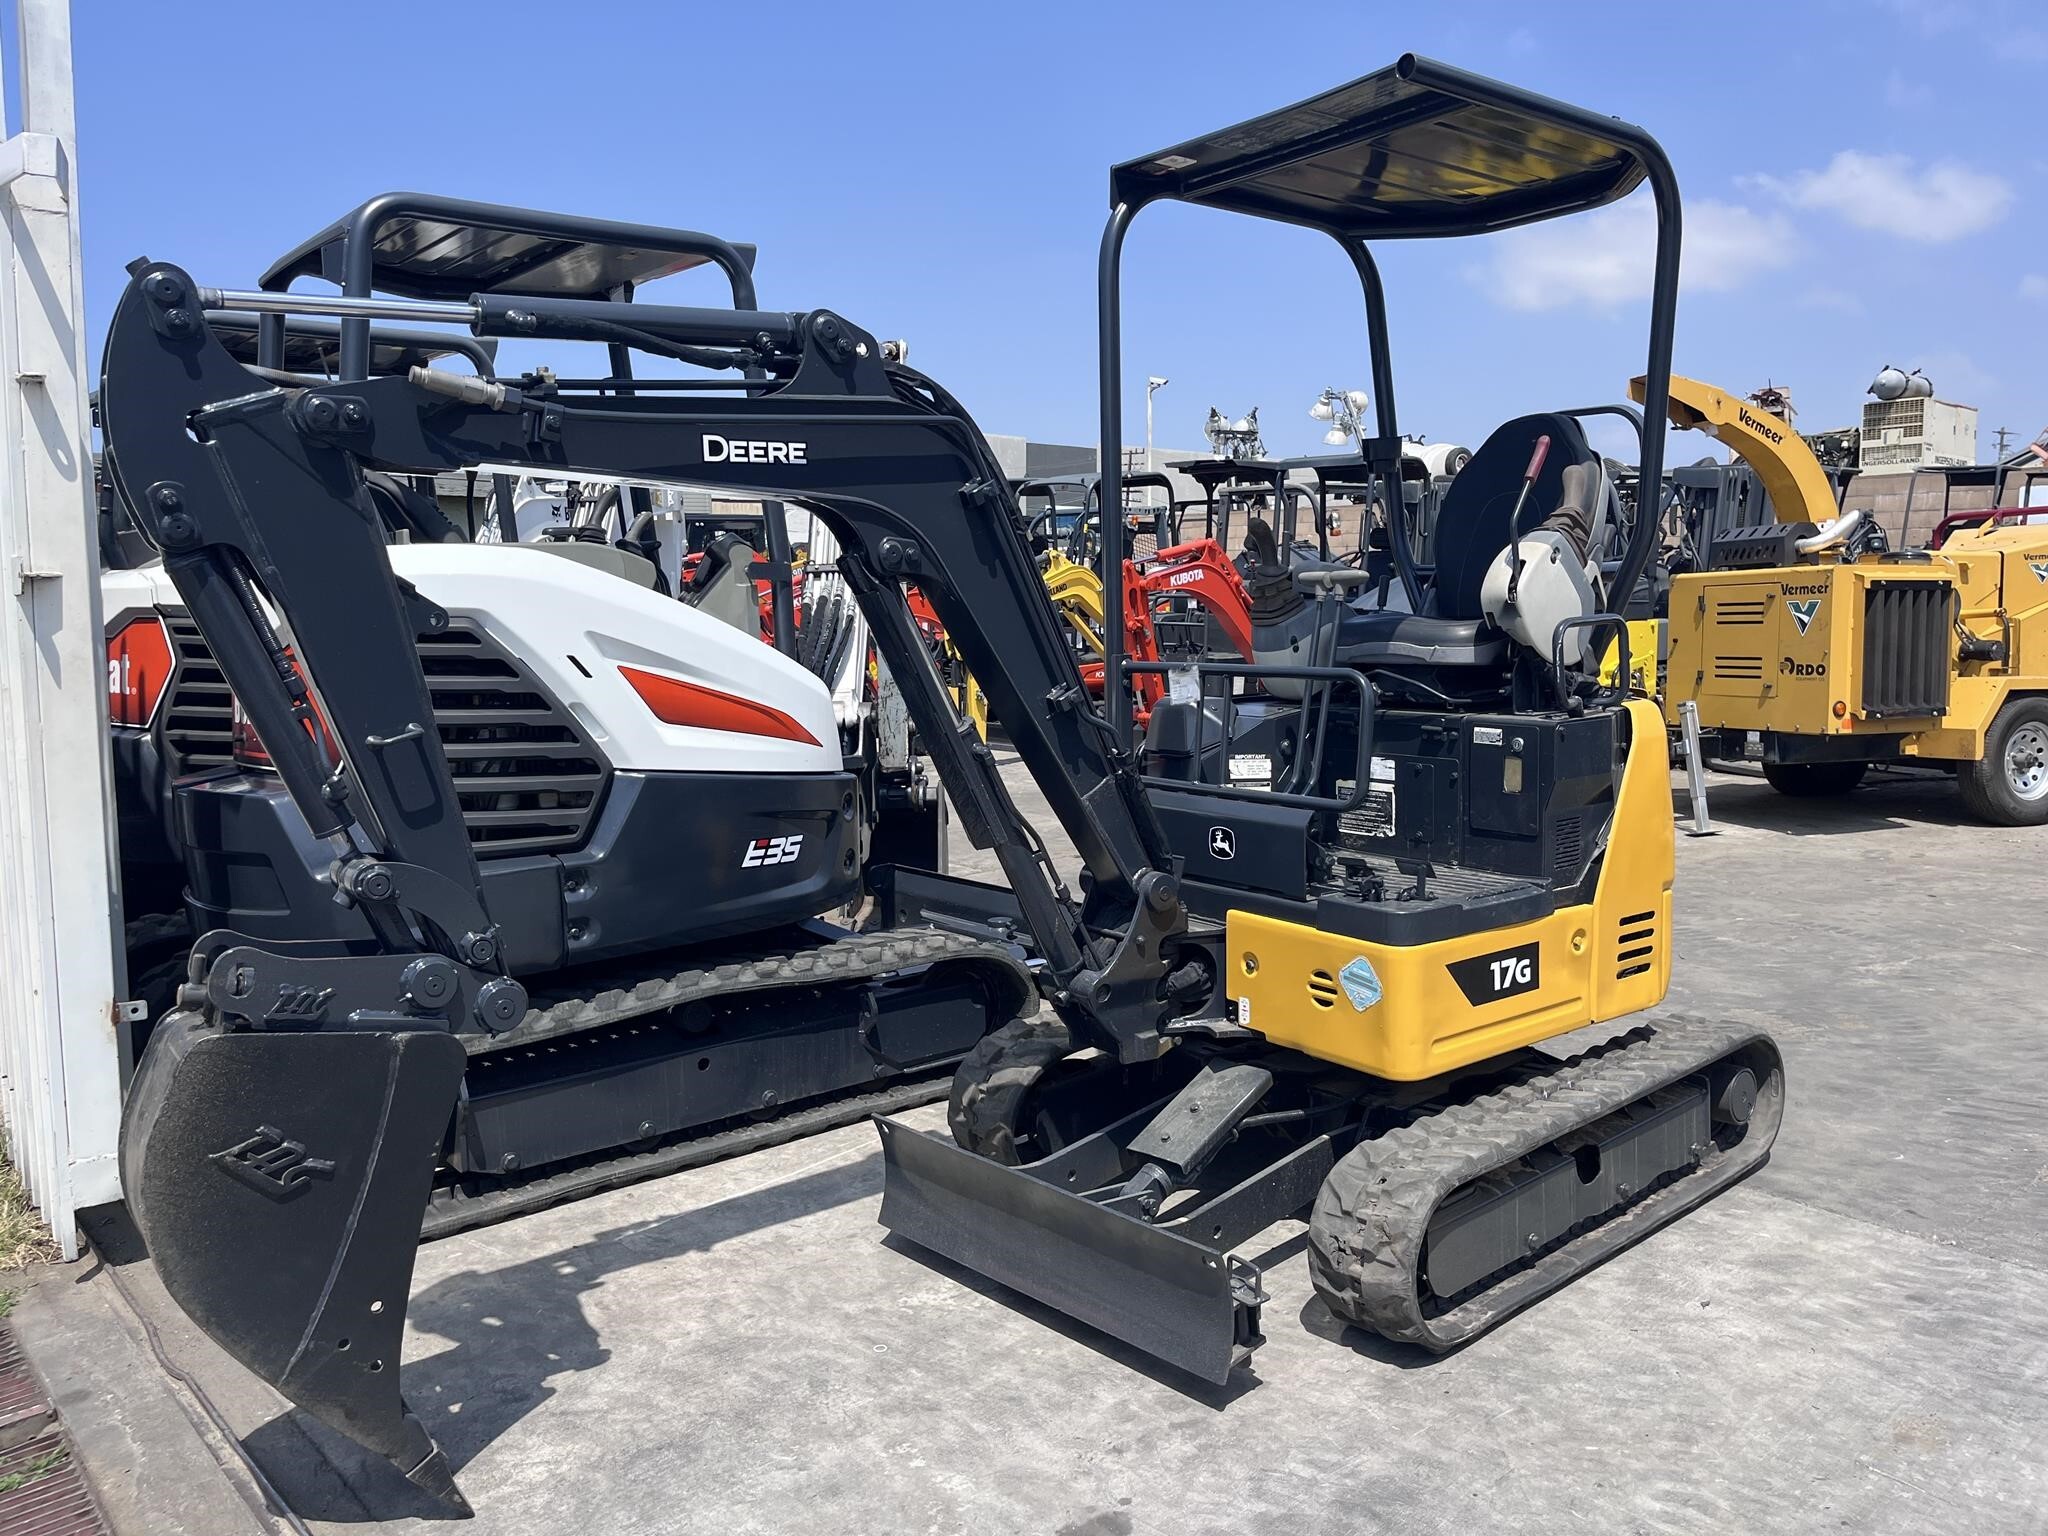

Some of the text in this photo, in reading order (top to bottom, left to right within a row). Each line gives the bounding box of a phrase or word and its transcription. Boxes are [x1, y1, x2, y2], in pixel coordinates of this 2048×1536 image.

[1739, 407, 1783, 444] Vermeer
[702, 434, 807, 464] DEERE
[2023, 553, 2048, 561] Verm
[1170, 568, 1204, 587] KUBOTA
[1780, 583, 1829, 596] Vermeer
[741, 834, 804, 868] E35
[1489, 956, 1532, 992] 17G
